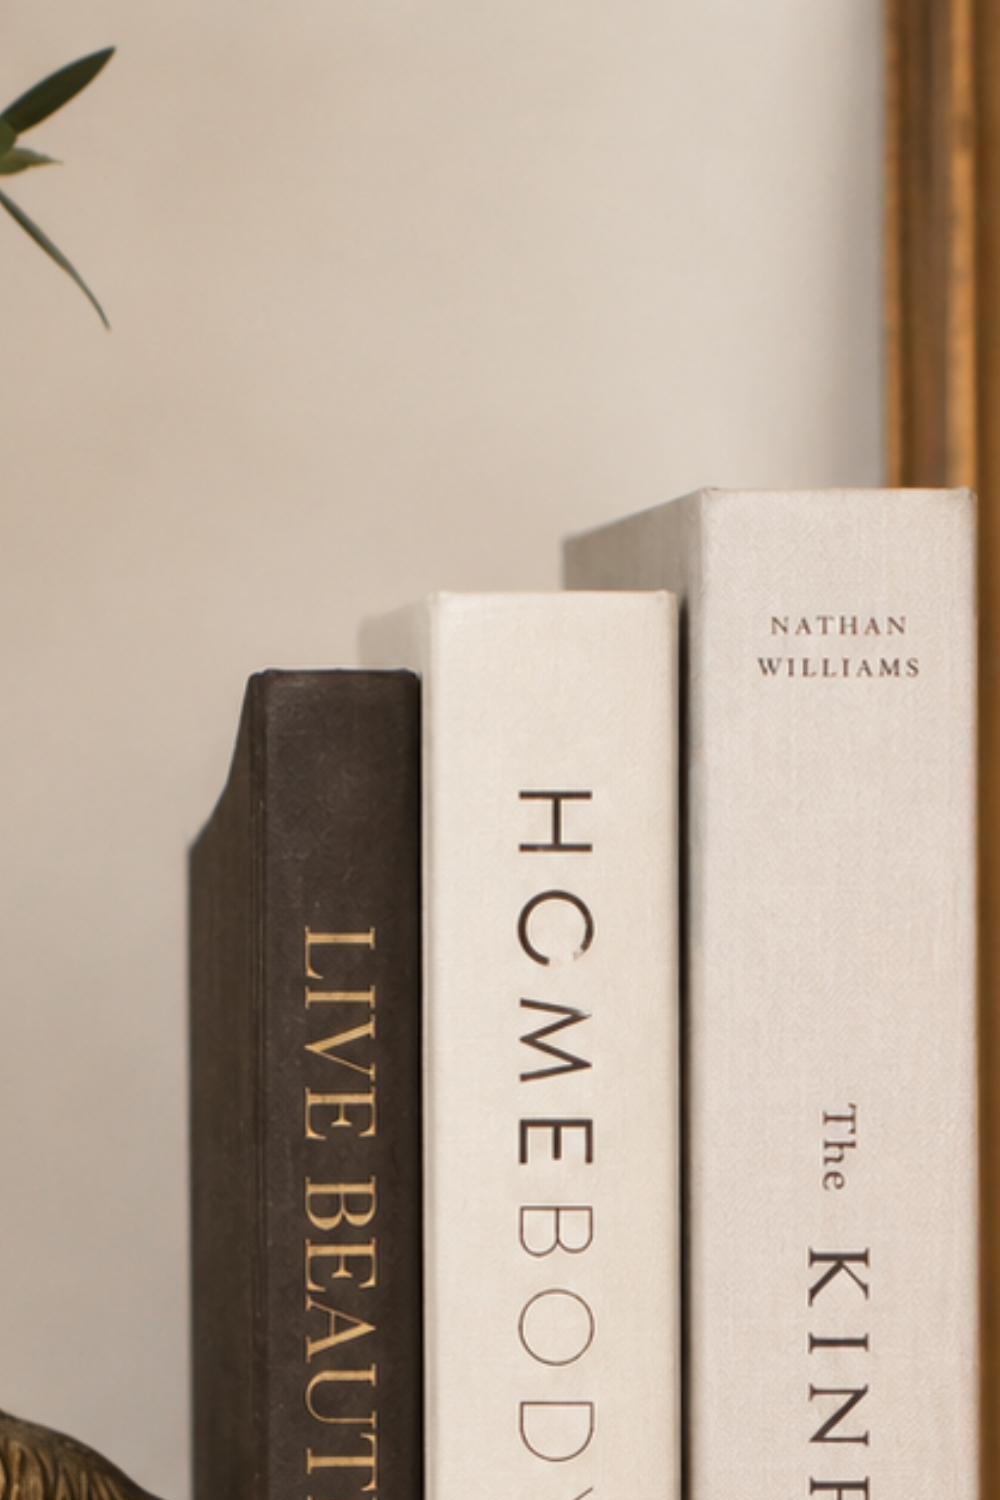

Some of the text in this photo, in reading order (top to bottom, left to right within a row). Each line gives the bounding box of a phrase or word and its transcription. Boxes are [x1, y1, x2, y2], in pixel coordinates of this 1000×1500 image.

[770, 615, 906, 636] NATHAN
[757, 656, 920, 678] WILLIAMS
[304, 925, 376, 1141] LIVE
[822, 1102, 858, 1191] The
